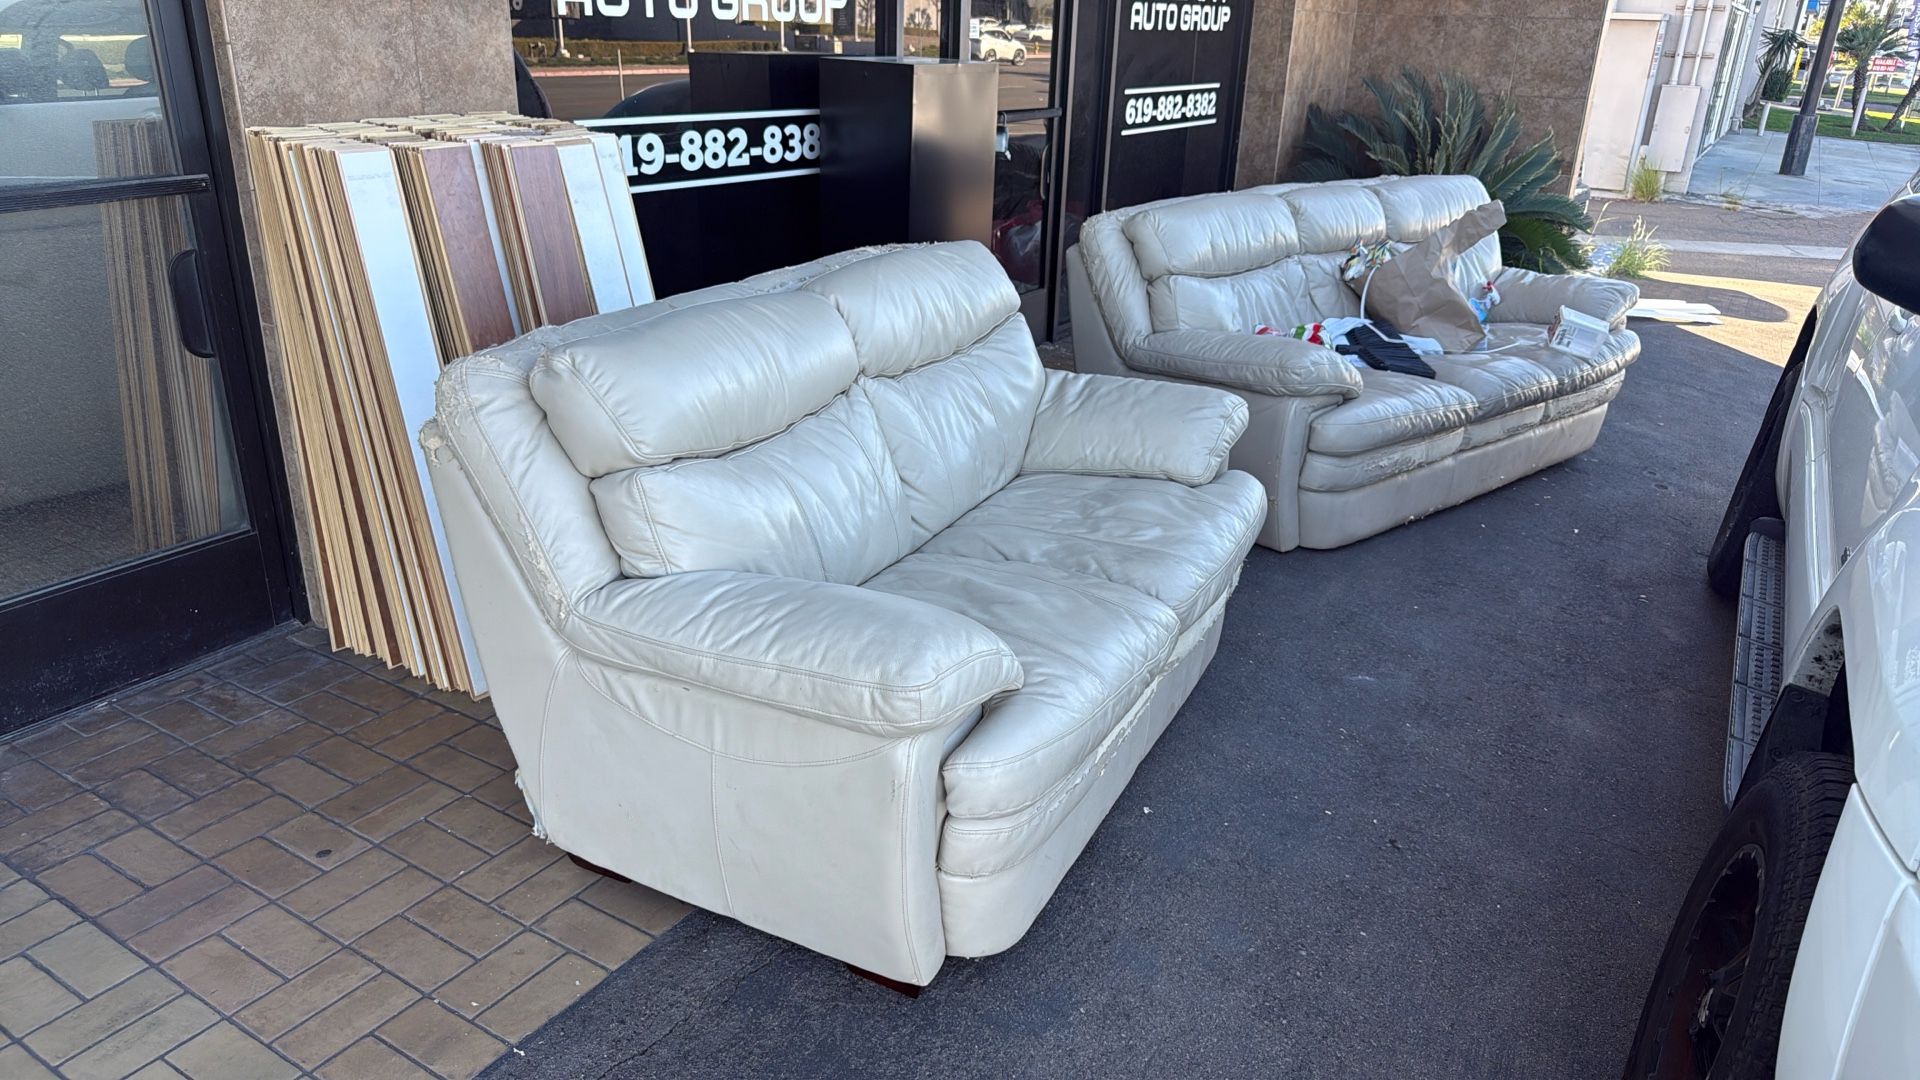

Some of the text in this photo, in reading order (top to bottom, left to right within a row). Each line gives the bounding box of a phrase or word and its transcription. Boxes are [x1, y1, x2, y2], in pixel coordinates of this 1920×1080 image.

[1130, 2, 1231, 32] AUTO GROUP
[1125, 92, 1217, 125] 619-882-8382
